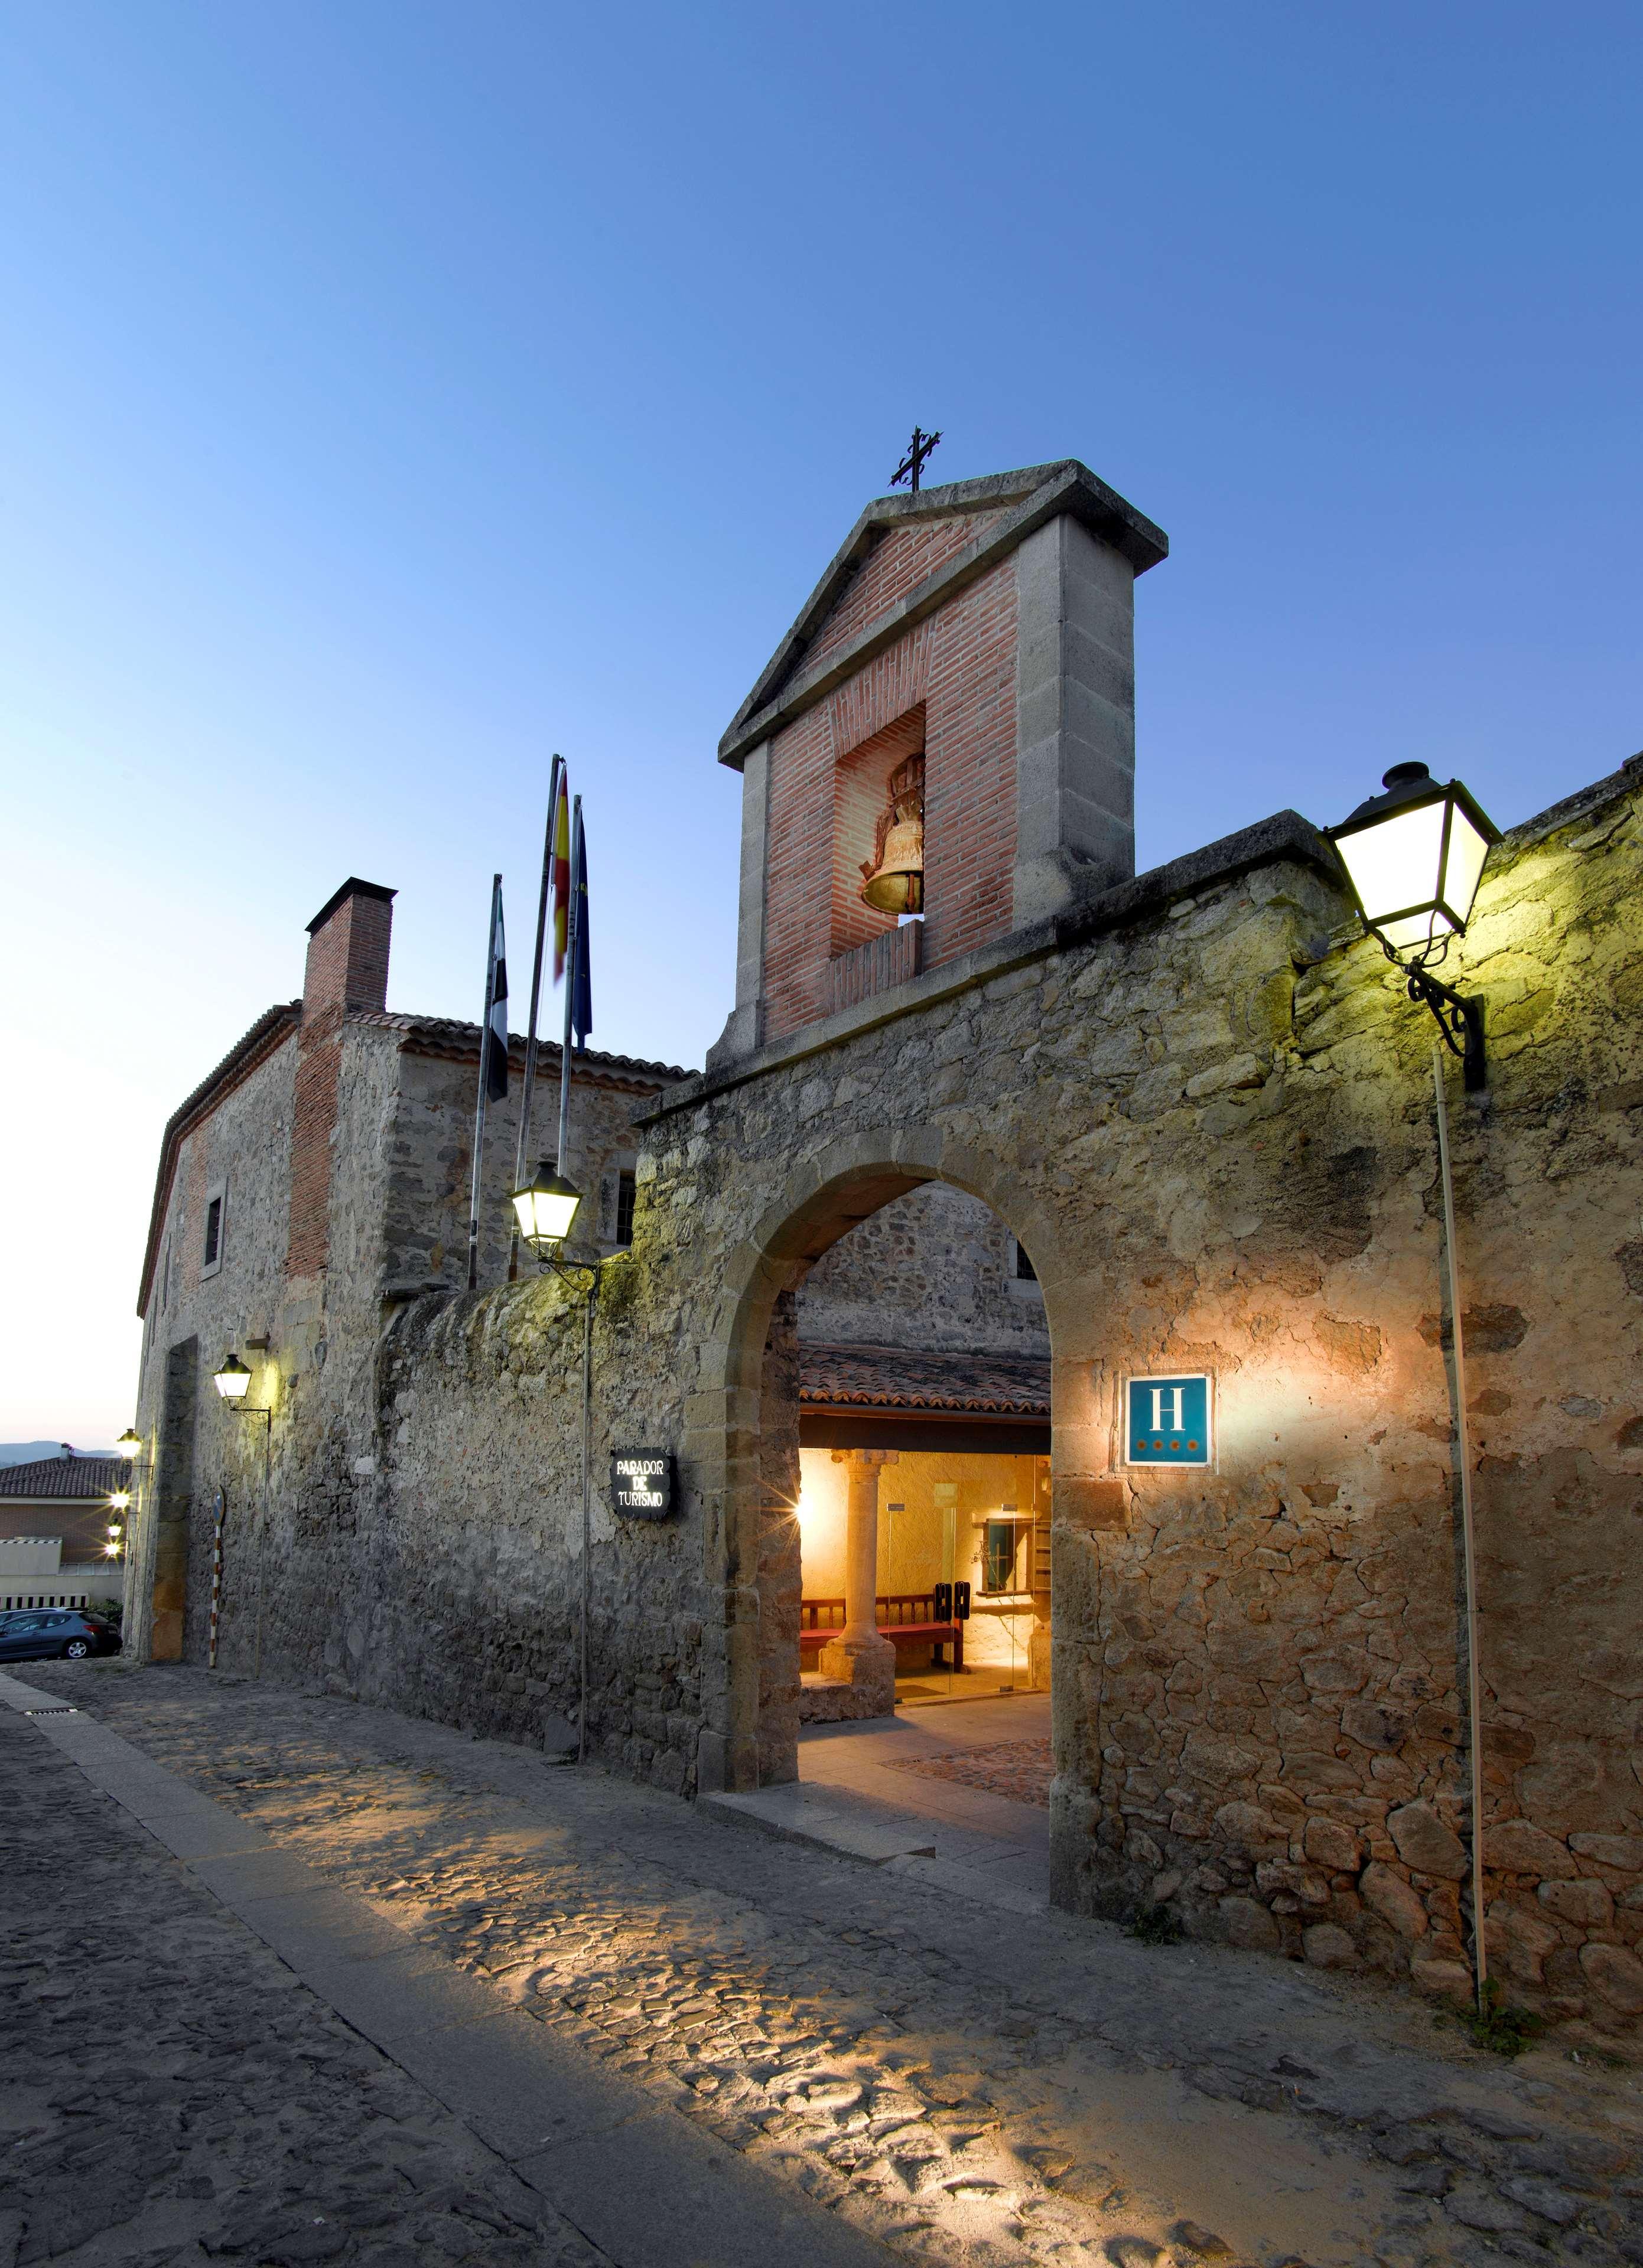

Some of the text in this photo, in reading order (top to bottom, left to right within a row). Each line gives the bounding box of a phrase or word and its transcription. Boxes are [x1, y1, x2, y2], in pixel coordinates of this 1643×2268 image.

[1149, 1387, 1186, 1430] H
[617, 1460, 663, 1475] PARADOR
[632, 1476, 648, 1491] DE
[618, 1491, 662, 1507] TURISMO
